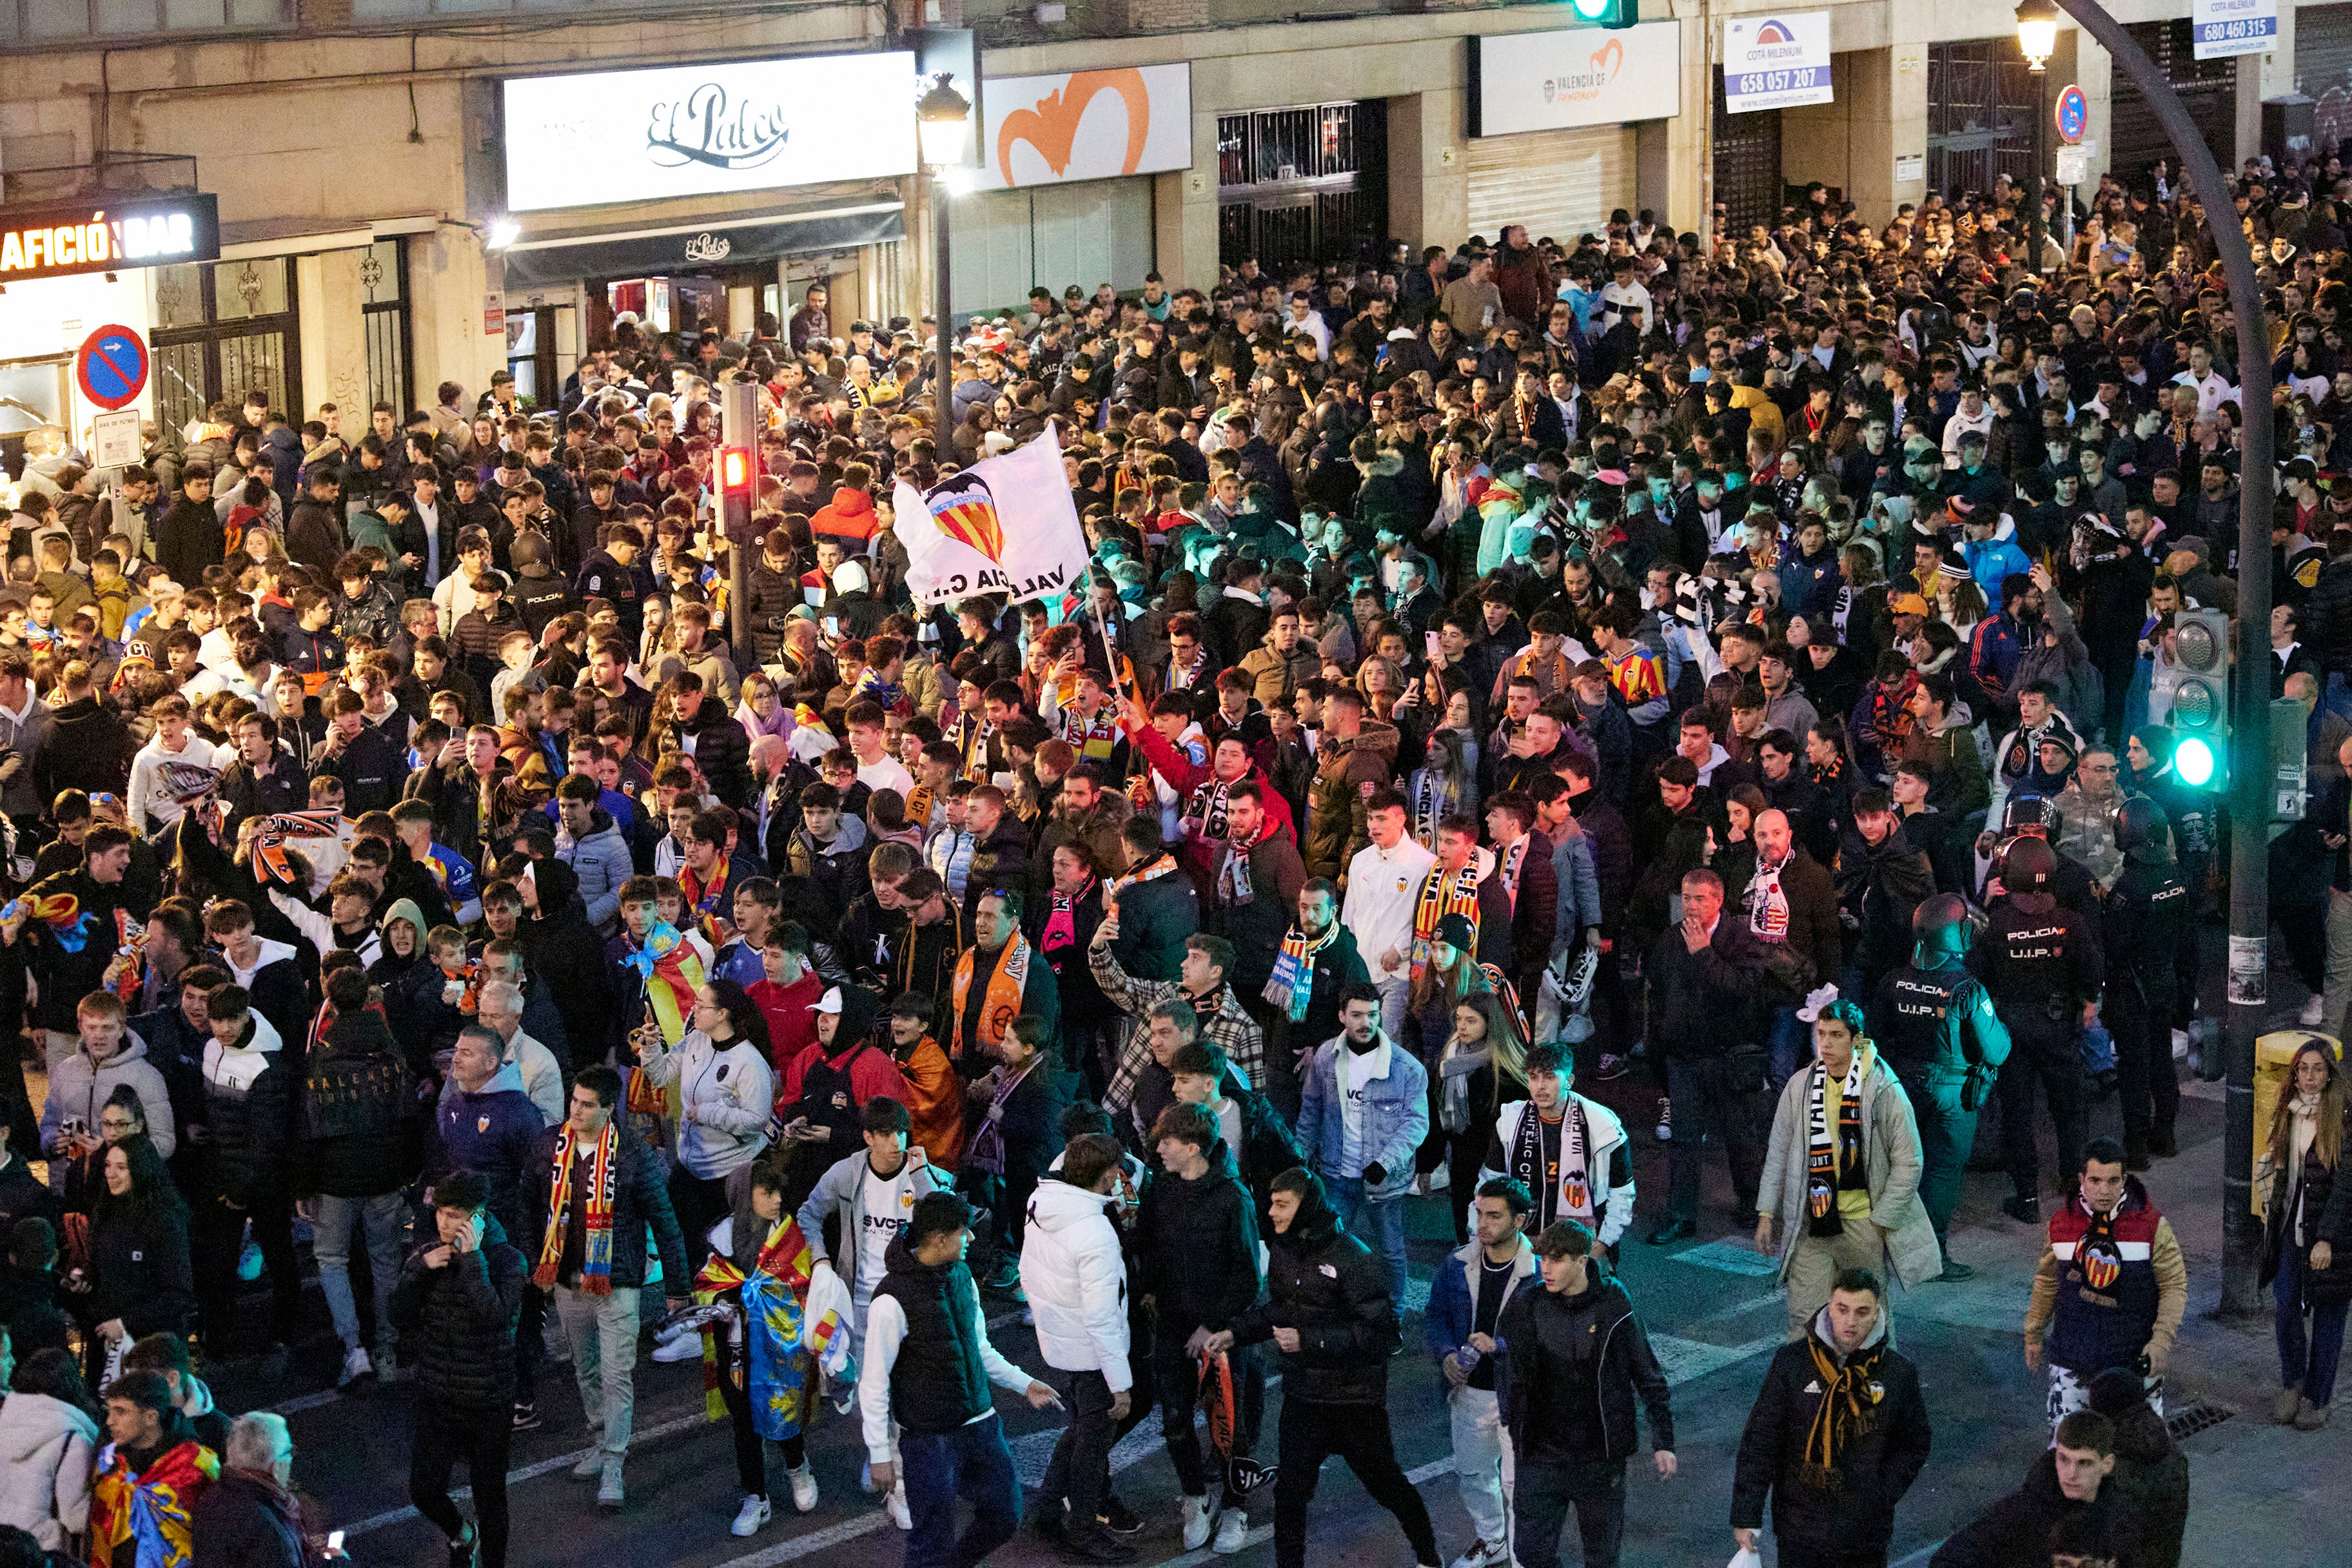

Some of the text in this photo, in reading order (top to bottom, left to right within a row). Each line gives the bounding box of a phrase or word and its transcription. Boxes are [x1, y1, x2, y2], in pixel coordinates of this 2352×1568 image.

[2205, 19, 2266, 41] 680 460 315
[1767, 46, 1803, 59] MILENIUM
[1557, 73, 1605, 90] VALENCIA CF
[1741, 68, 1816, 93] 658 057 207
[647, 83, 789, 153] El Palco
[1282, 168, 1291, 179] 17
[123, 213, 194, 259] BAR
[685, 233, 730, 256] El Palco
[527, 593, 560, 604] POLICIA
[911, 801, 926, 816] CF
[1455, 867, 1478, 901] C.F.
[2152, 887, 2184, 901] POLICIA
[2007, 927, 2059, 941] POLICIA
[2010, 948, 2052, 958] U.I.P.
[1896, 981, 1943, 995] POLICIA
[1898, 1003, 1936, 1017] U.I.P.
